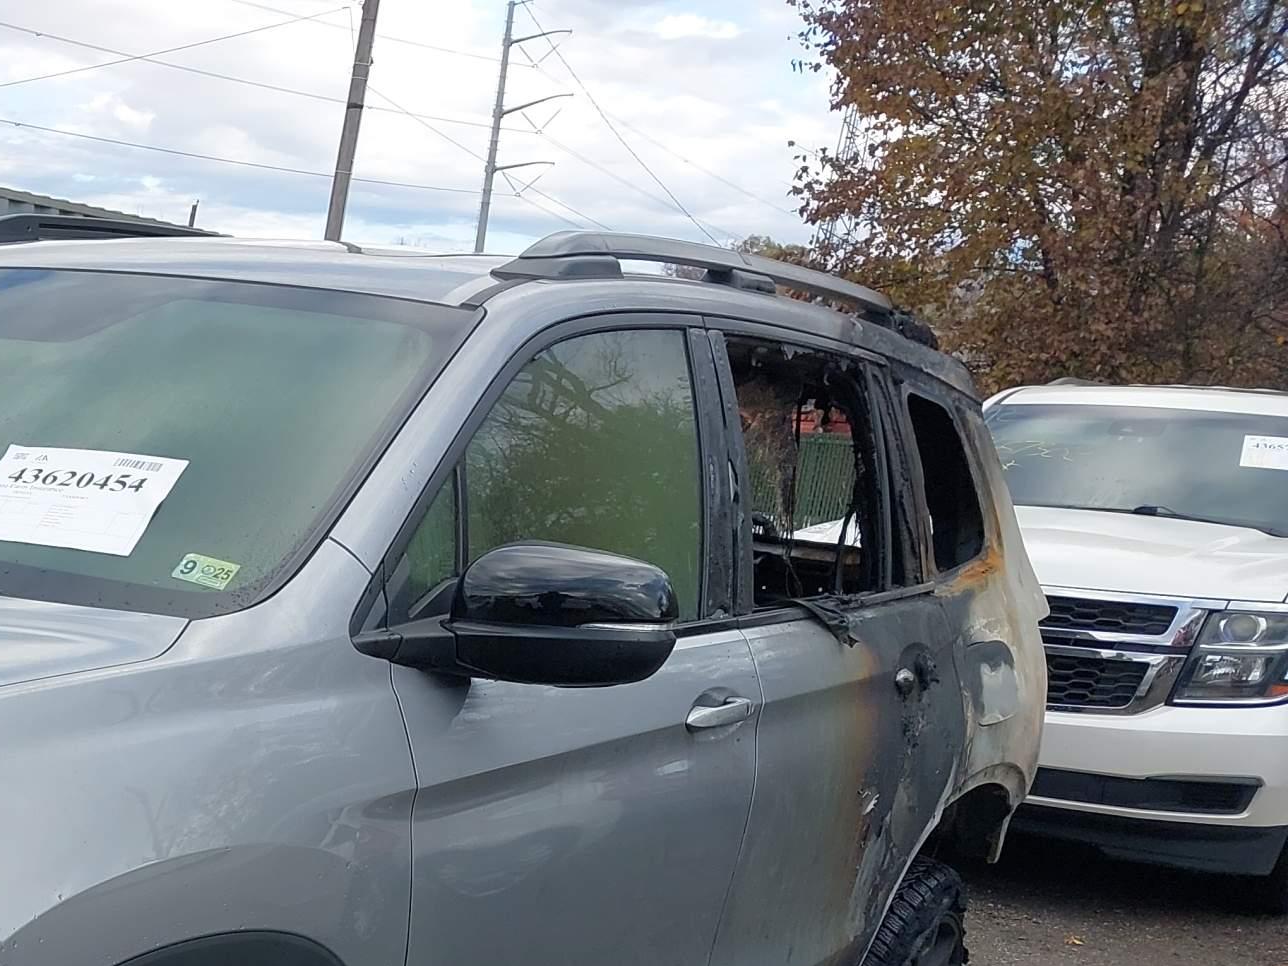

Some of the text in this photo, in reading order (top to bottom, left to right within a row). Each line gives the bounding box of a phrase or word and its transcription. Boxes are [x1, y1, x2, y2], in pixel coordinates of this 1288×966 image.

[8, 467, 148, 493] 43620454
[179, 559, 233, 580] 9 25
